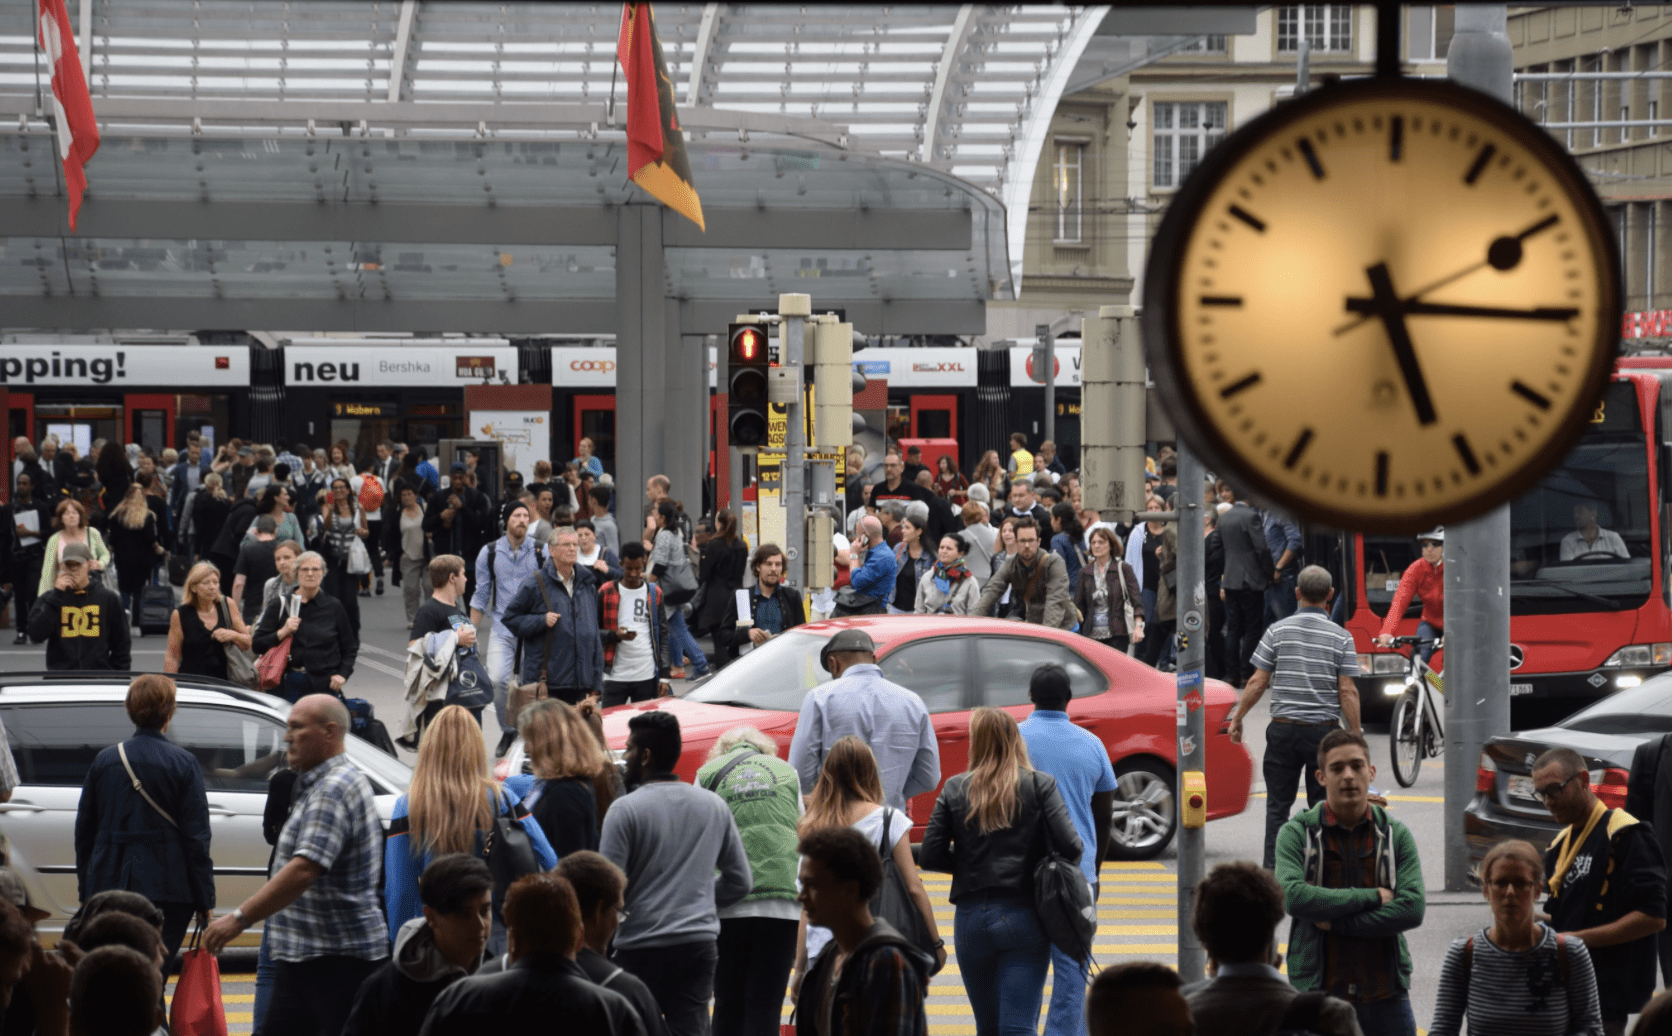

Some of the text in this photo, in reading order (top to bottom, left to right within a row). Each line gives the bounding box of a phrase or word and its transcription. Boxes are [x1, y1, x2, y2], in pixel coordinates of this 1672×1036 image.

[0, 351, 126, 384] pping!
[294, 362, 360, 382] neu
[379, 360, 431, 374] Bershka
[570, 360, 616, 374] coop
[61, 604, 100, 638] DC
